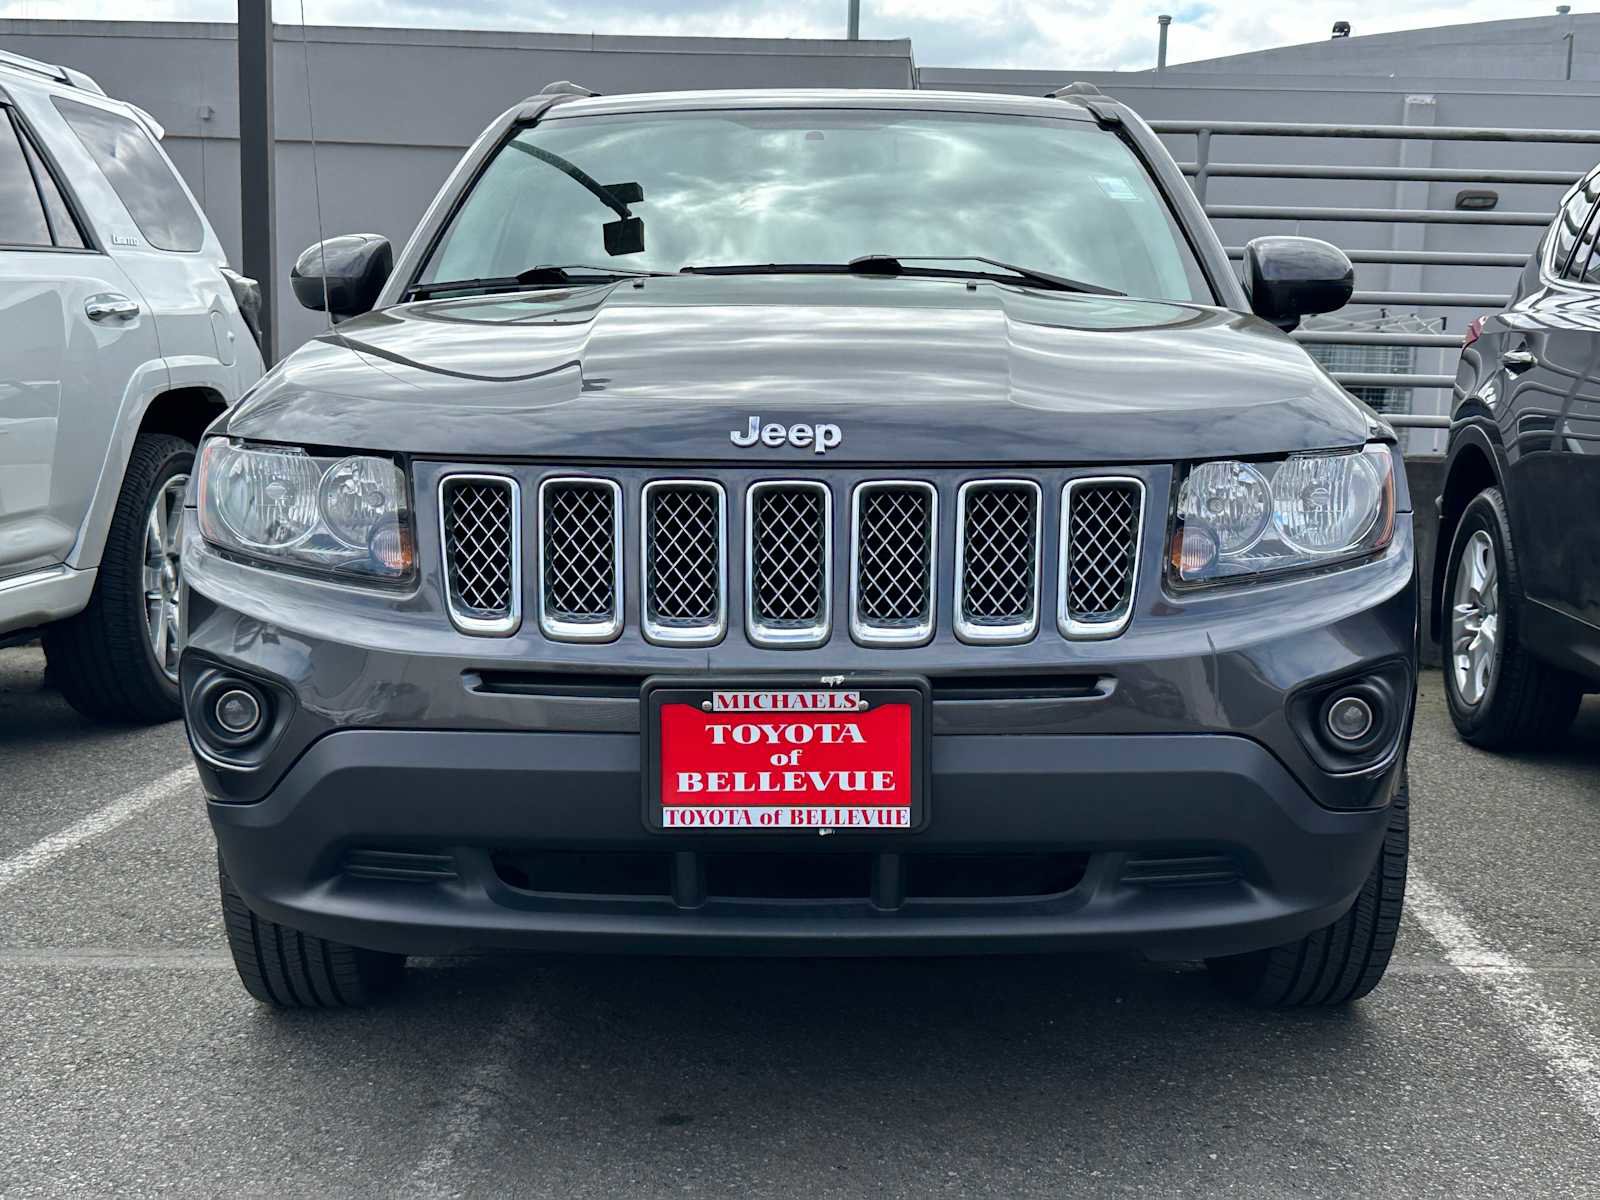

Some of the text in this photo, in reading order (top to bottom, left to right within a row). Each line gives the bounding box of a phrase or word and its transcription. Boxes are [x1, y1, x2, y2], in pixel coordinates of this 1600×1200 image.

[730, 416, 842, 455] Jeep
[717, 693, 857, 709] MICHAELS
[705, 723, 866, 744] TOYOTA
[770, 749, 803, 766] of
[676, 771, 896, 793] BELLEVUE
[665, 808, 909, 825] TOYOTA of BELLEVUE
